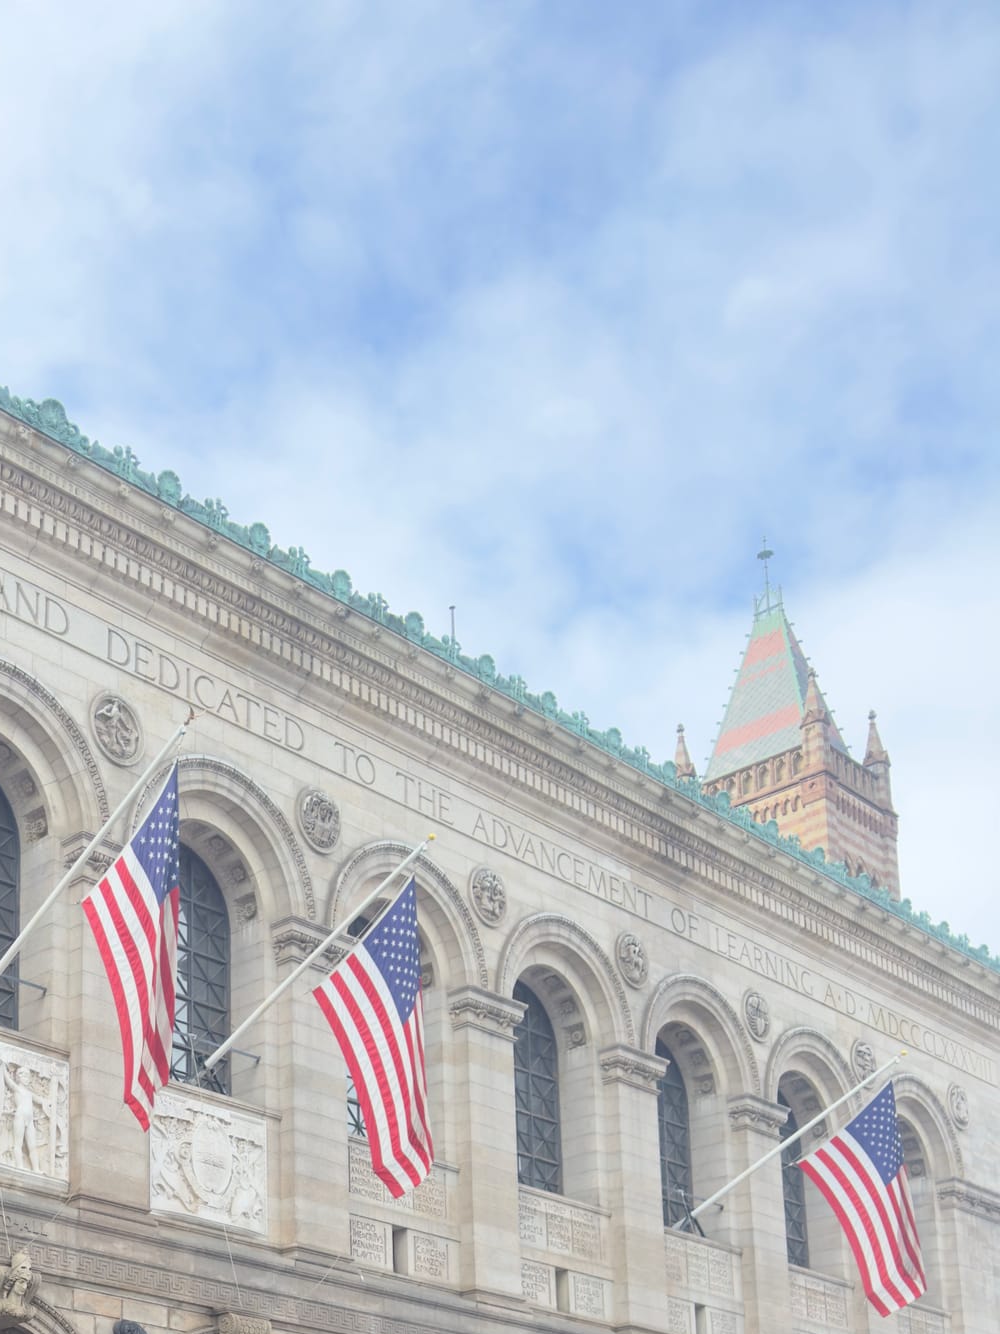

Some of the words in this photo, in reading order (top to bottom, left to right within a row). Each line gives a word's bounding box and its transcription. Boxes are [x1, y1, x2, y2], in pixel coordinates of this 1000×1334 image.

[107, 627, 304, 752] DEDICATED
[334, 742, 376, 785] TO
[395, 771, 455, 826] THE
[471, 812, 652, 918] ADVANCEMENT
[670, 907, 699, 939] OF
[714, 927, 813, 997] LEARNING
